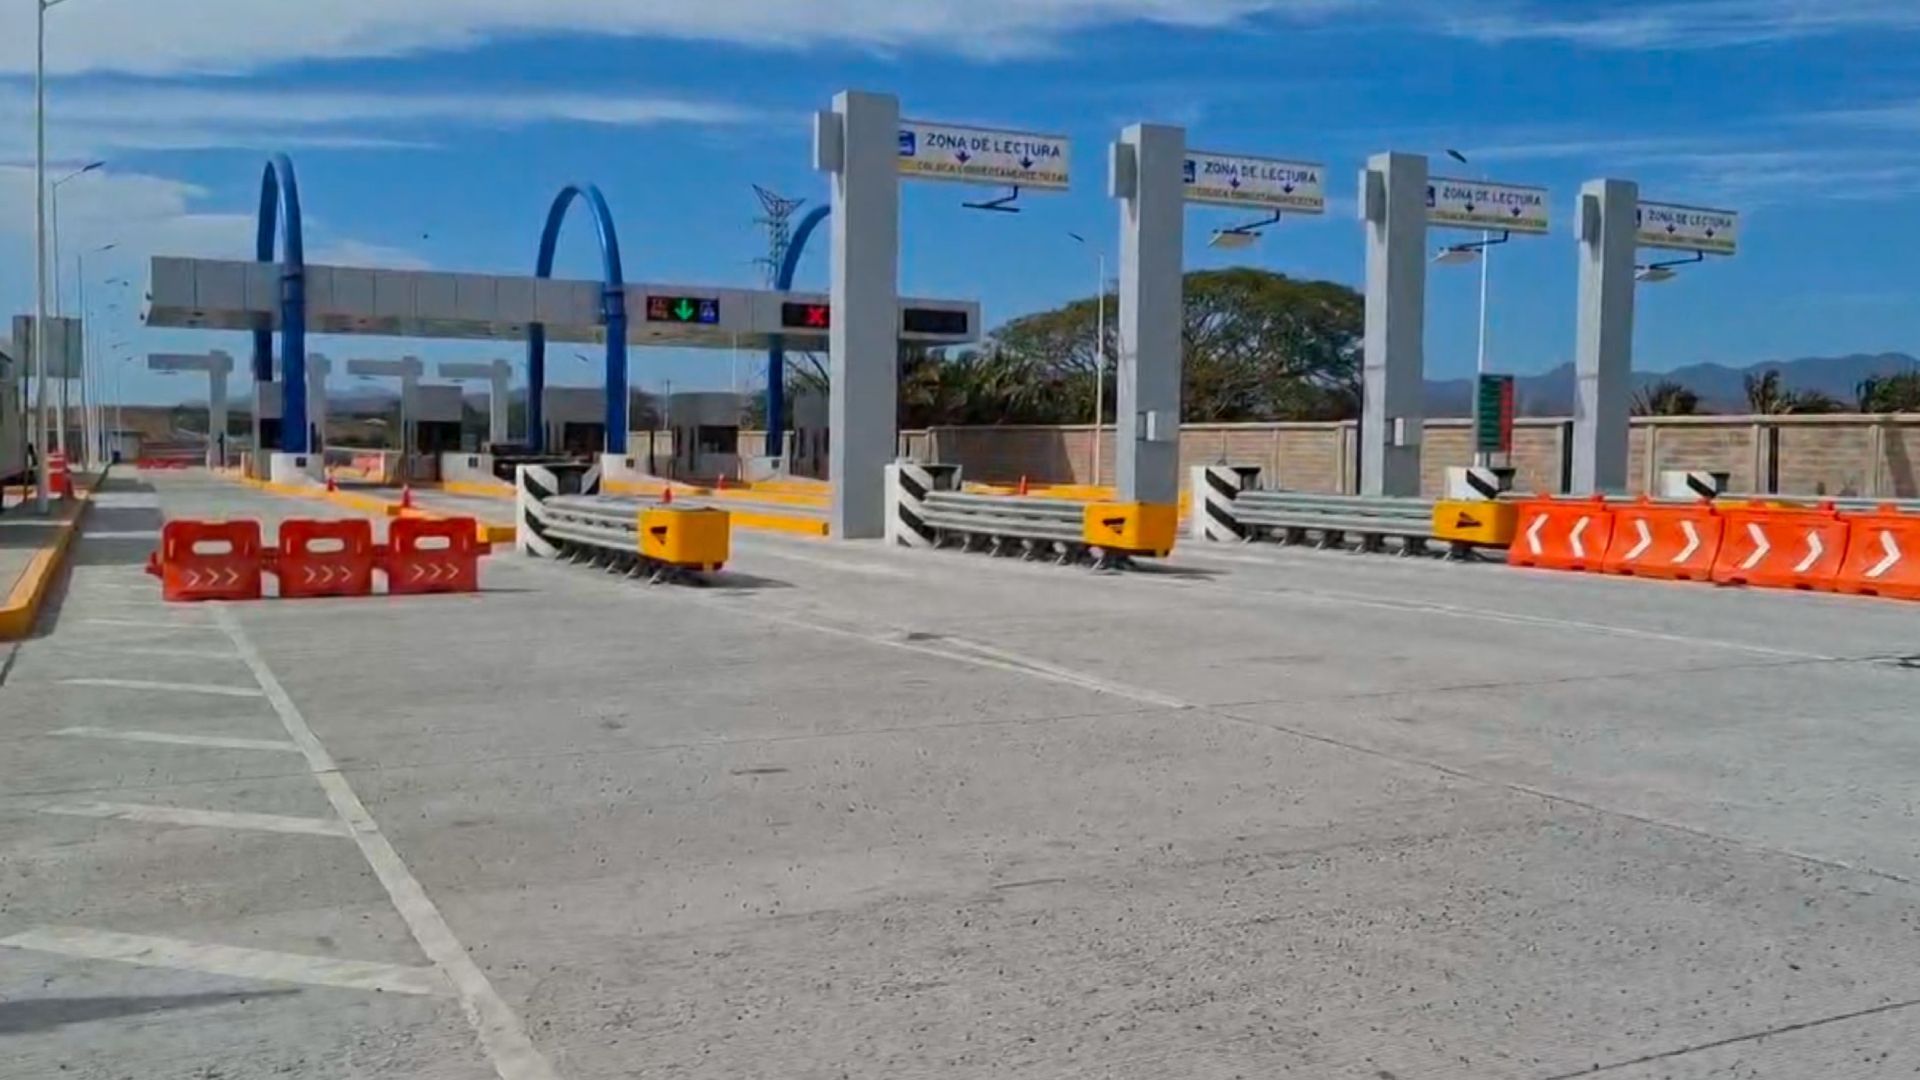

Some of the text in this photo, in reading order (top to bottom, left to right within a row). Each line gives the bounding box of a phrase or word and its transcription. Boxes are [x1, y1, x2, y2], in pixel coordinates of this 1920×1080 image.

[927, 133, 1060, 157] ZONA DE LECTURA
[1204, 161, 1317, 183] ZONA DE LECTURA
[1443, 186, 1541, 206] ZONA DE LECTURA
